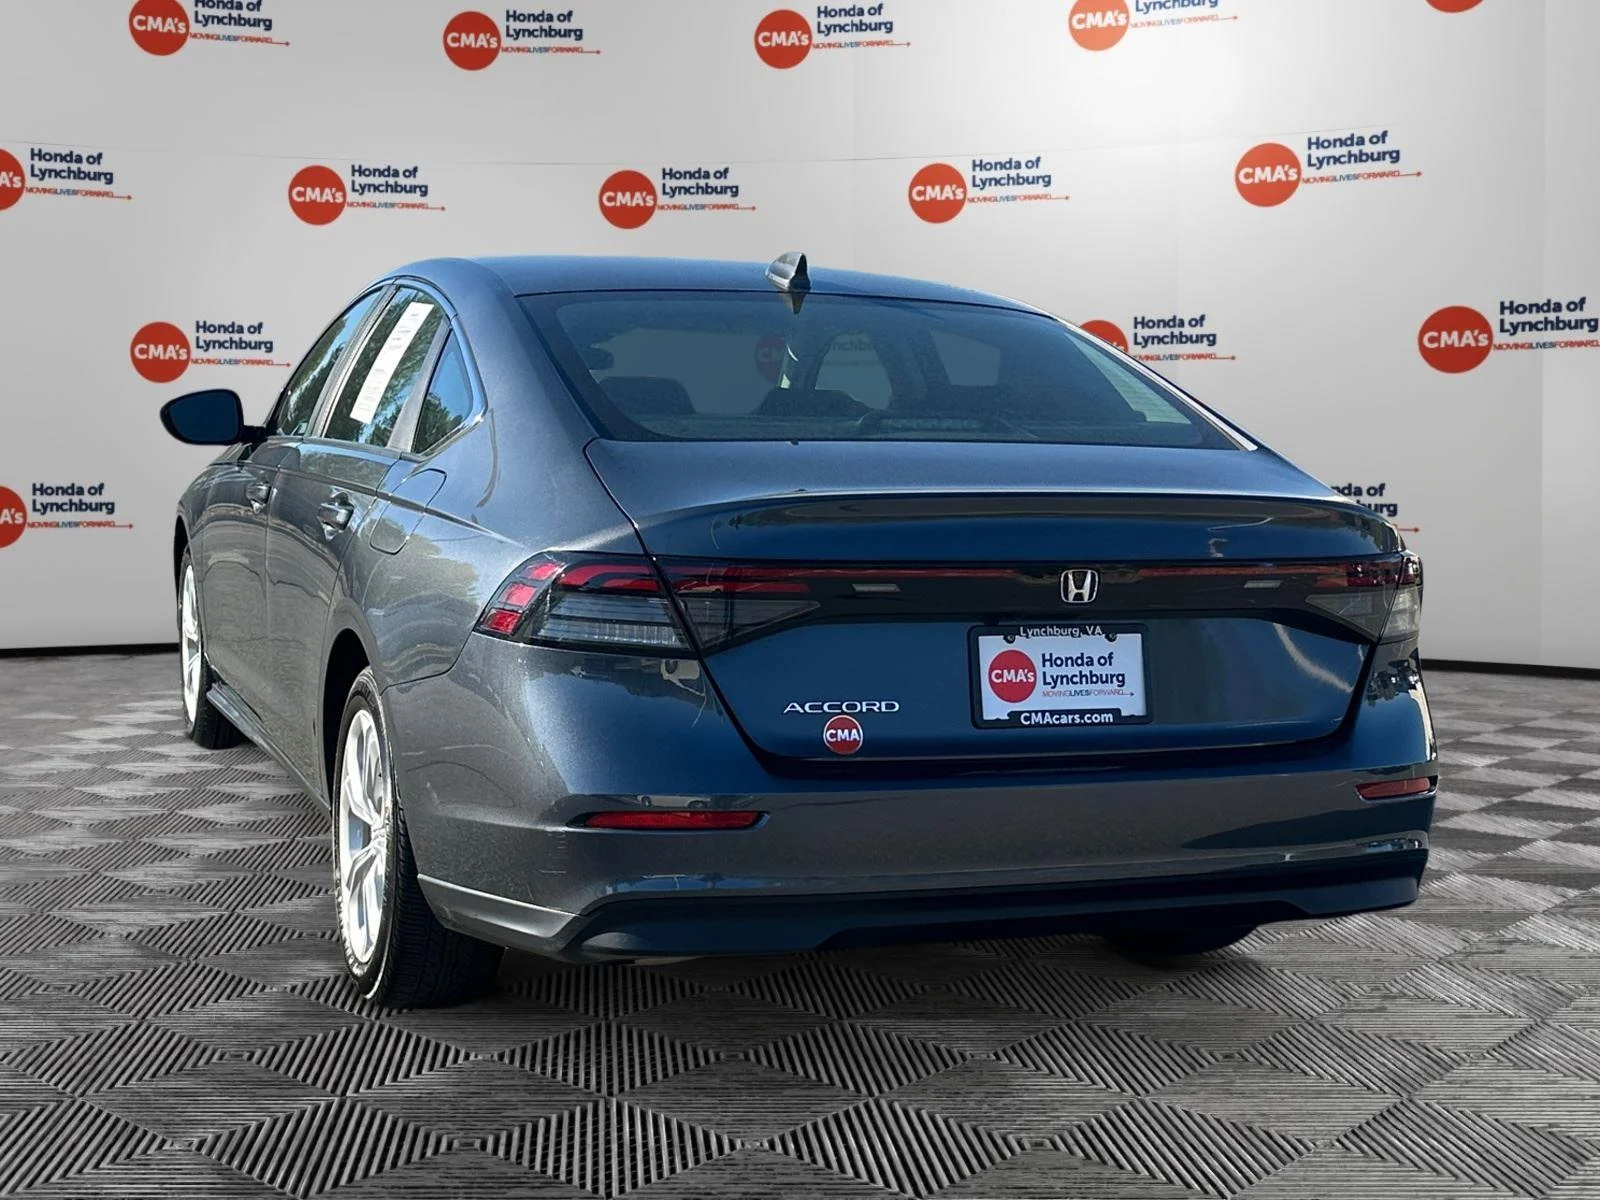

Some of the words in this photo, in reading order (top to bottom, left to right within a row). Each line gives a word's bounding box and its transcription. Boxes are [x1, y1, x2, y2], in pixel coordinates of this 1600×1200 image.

[194, 0, 243, 11] Honda
[246, 0, 262, 12] of
[817, 5, 864, 18] Honda
[867, 3, 883, 16] of
[132, 14, 187, 34] CMA's
[194, 11, 272, 31] Lynchburg
[505, 10, 554, 22] Honda
[556, 10, 573, 22] of
[1071, 9, 1127, 30] CMA's
[505, 25, 583, 41] Lynchburg
[817, 19, 893, 37] Lynchburg
[446, 32, 498, 48] CMA's
[757, 30, 809, 47] CMA's
[1307, 133, 1365, 150] Honda
[1368, 130, 1388, 145] of
[30, 148, 83, 164] Honda
[85, 152, 103, 165] of
[972, 157, 1020, 171] Honda
[1025, 156, 1041, 170] of
[1307, 149, 1400, 170] Lynchburg
[0, 171, 22, 188] A's
[30, 163, 114, 185] Lynchburg
[351, 164, 399, 178] Honda
[402, 166, 418, 179] of
[661, 167, 710, 180] Honda
[713, 167, 729, 180] of
[1238, 164, 1297, 184] CMA's
[351, 179, 428, 197] Lynchburg
[972, 172, 1051, 190] Lynchburg
[291, 187, 343, 203] CMA's
[661, 182, 739, 198] Lynchburg
[911, 184, 964, 202] CMA's
[602, 191, 654, 207] CMA's
[1500, 298, 1562, 315] Honda
[1566, 296, 1586, 311] of
[195, 320, 244, 334] Honda
[247, 322, 263, 334] of
[1133, 315, 1184, 329] Honda
[1188, 314, 1206, 328] of
[1499, 316, 1599, 336] Lynchburg
[195, 336, 273, 353] Lynchburg
[1133, 331, 1217, 348] Lynchburg
[1422, 329, 1489, 349] CMA's
[134, 343, 188, 360] CMA's
[32, 483, 84, 496] Honda
[87, 483, 104, 496] of
[1366, 482, 1386, 496] of
[32, 499, 115, 515] Lynchburg
[0, 508, 23, 524] A's
[1020, 626, 1084, 637] Lynchburg,
[1086, 625, 1103, 635] VA
[1042, 653, 1094, 667] Honda
[1097, 652, 1114, 666] of
[991, 669, 1035, 683] CMA's
[1042, 670, 1125, 688] Lynchburg
[783, 701, 900, 713] ACCORD
[1020, 712, 1113, 725] CMAcars.com
[826, 729, 860, 742] CMA
